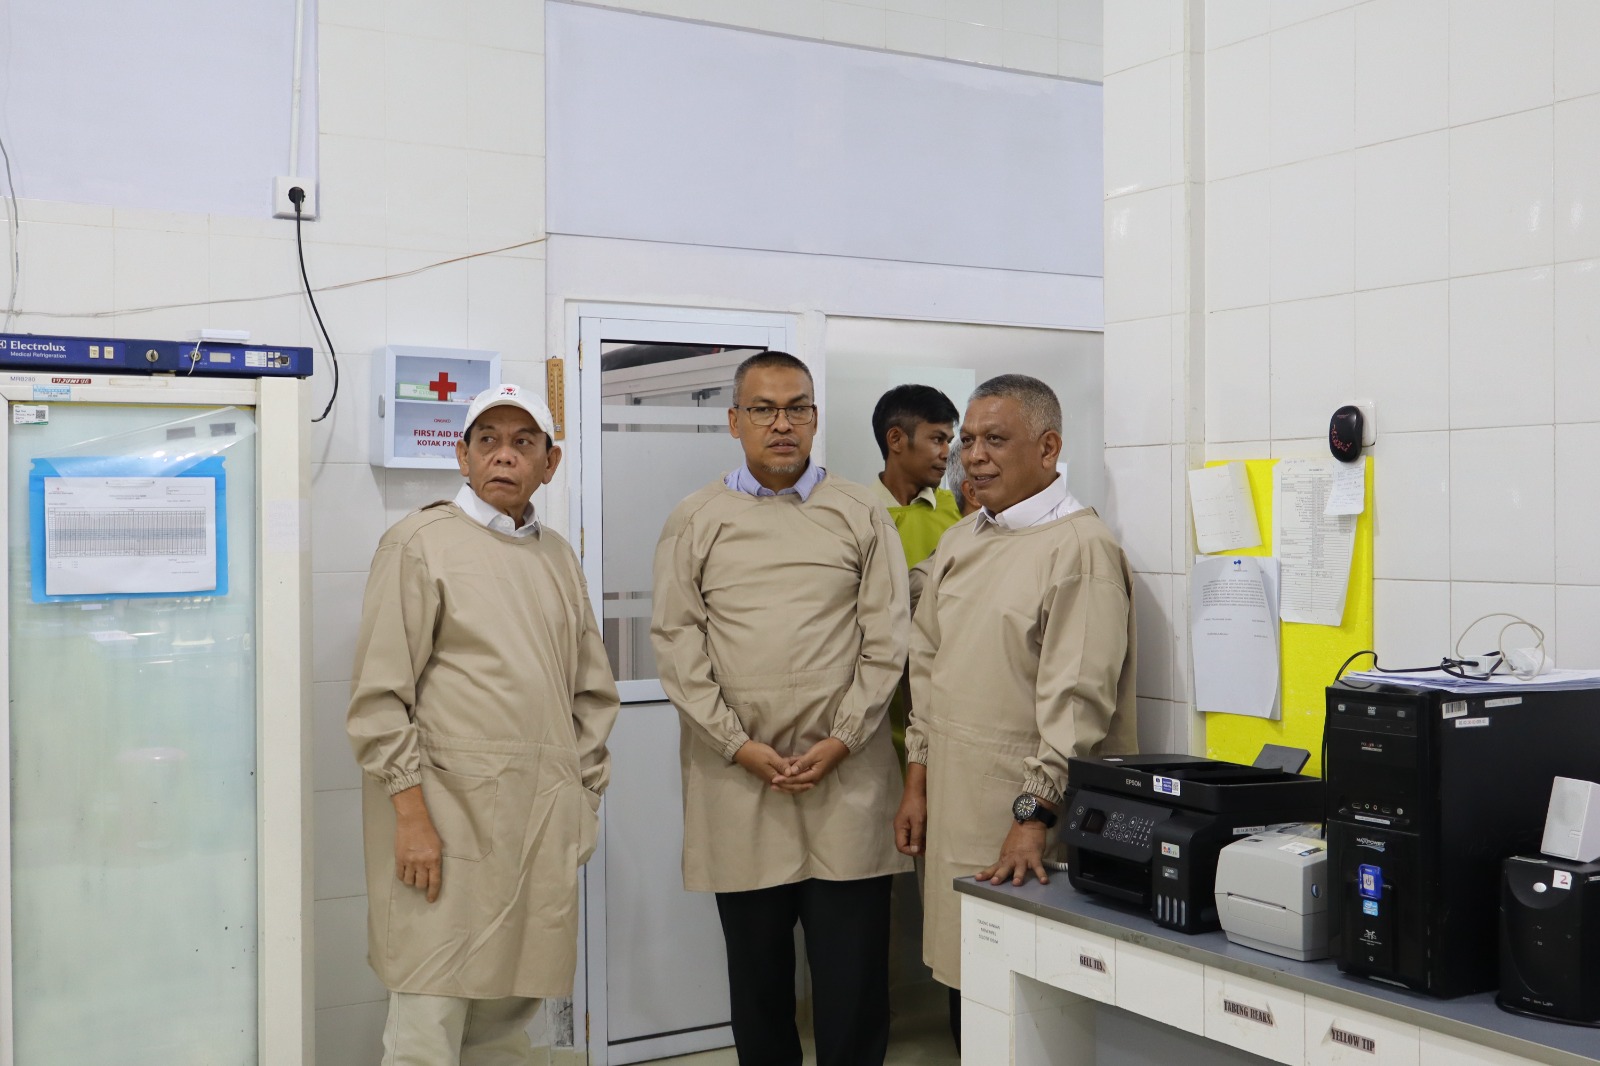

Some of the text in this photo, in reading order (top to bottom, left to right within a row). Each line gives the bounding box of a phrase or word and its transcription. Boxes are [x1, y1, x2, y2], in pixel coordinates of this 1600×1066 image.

[10, 340, 66, 352] Electrolux
[413, 429, 436, 437] FIRST
[437, 430, 452, 438] AID
[417, 439, 441, 447] KOTAK
[1125, 779, 1142, 788] EPSON
[1559, 874, 1569, 885] 2
[1079, 955, 1093, 968] GELL
[1223, 1000, 1249, 1018] TABUNG
[1331, 1028, 1375, 1052] YELLOW TIP
